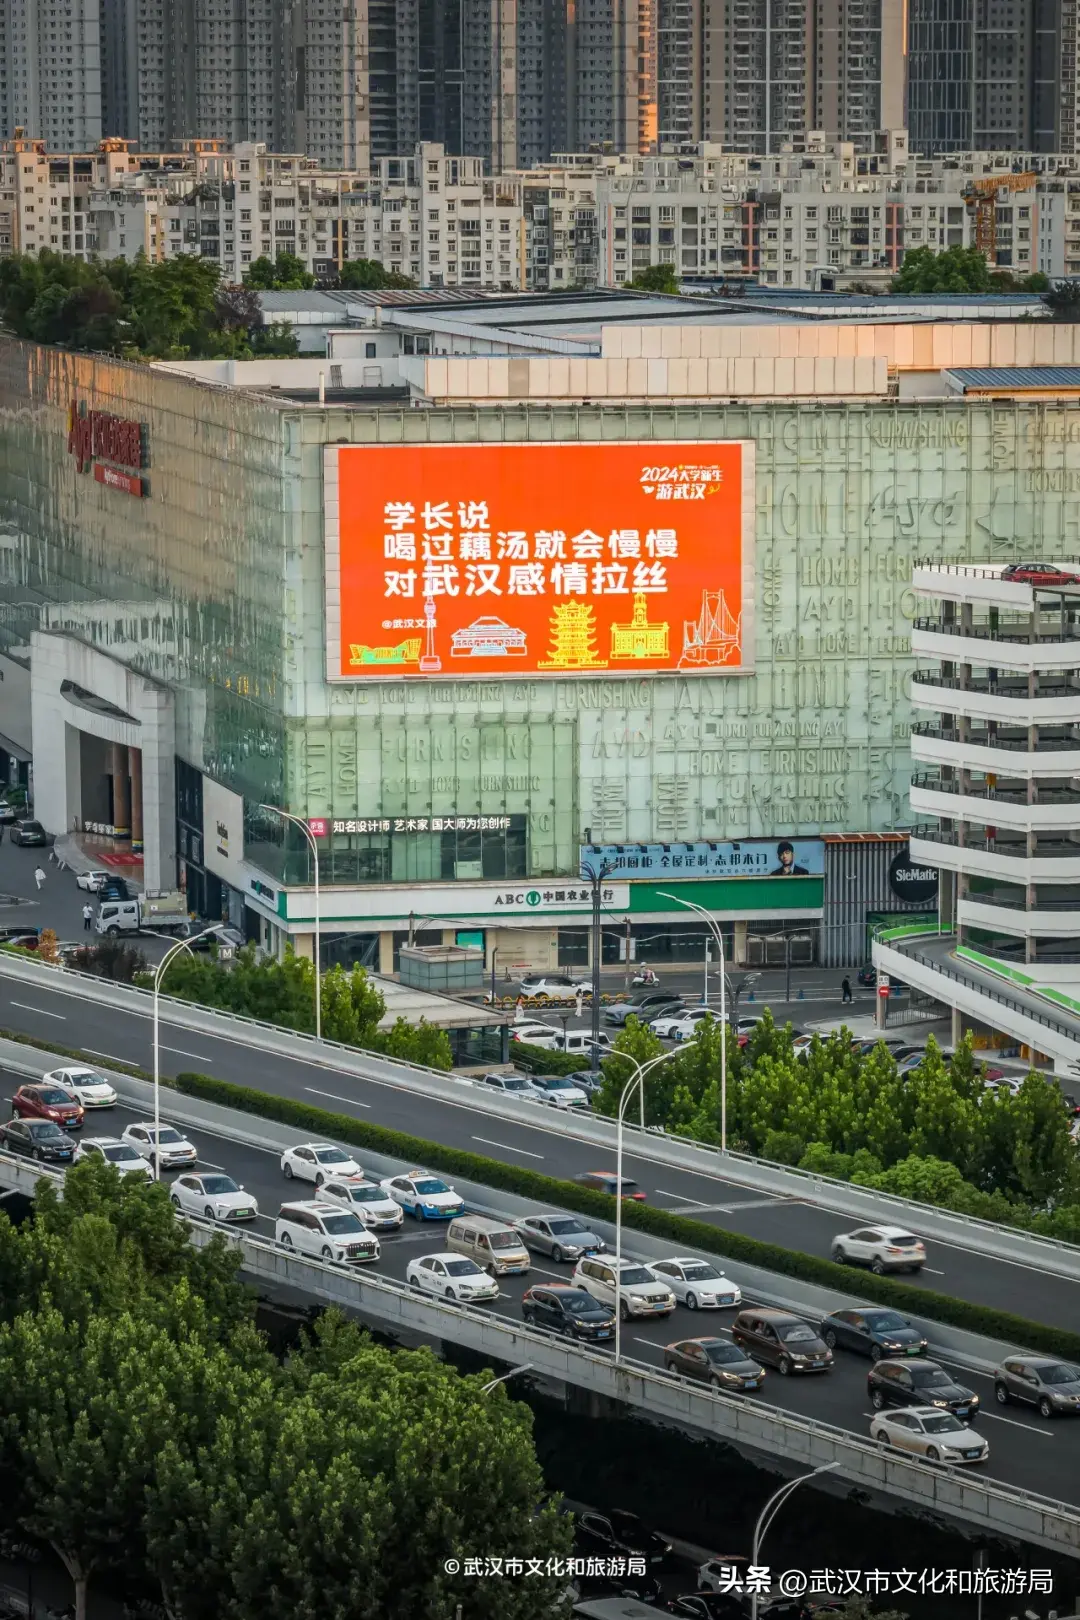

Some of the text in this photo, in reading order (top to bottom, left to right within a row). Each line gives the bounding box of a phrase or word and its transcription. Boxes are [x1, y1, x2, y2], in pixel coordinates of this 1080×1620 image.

[656, 483, 707, 500] 游武汉
[384, 501, 490, 531] 学长说
[384, 529, 678, 561] 喝过藕汤就会慢慢
[384, 561, 668, 598] 对武汉感情拉丝
[333, 820, 390, 834] 知名设计师
[394, 818, 428, 832] 艺术家
[432, 816, 511, 831] 国大师为您创作
[896, 868, 938, 882] SieMatic
[495, 894, 524, 905] ABC
